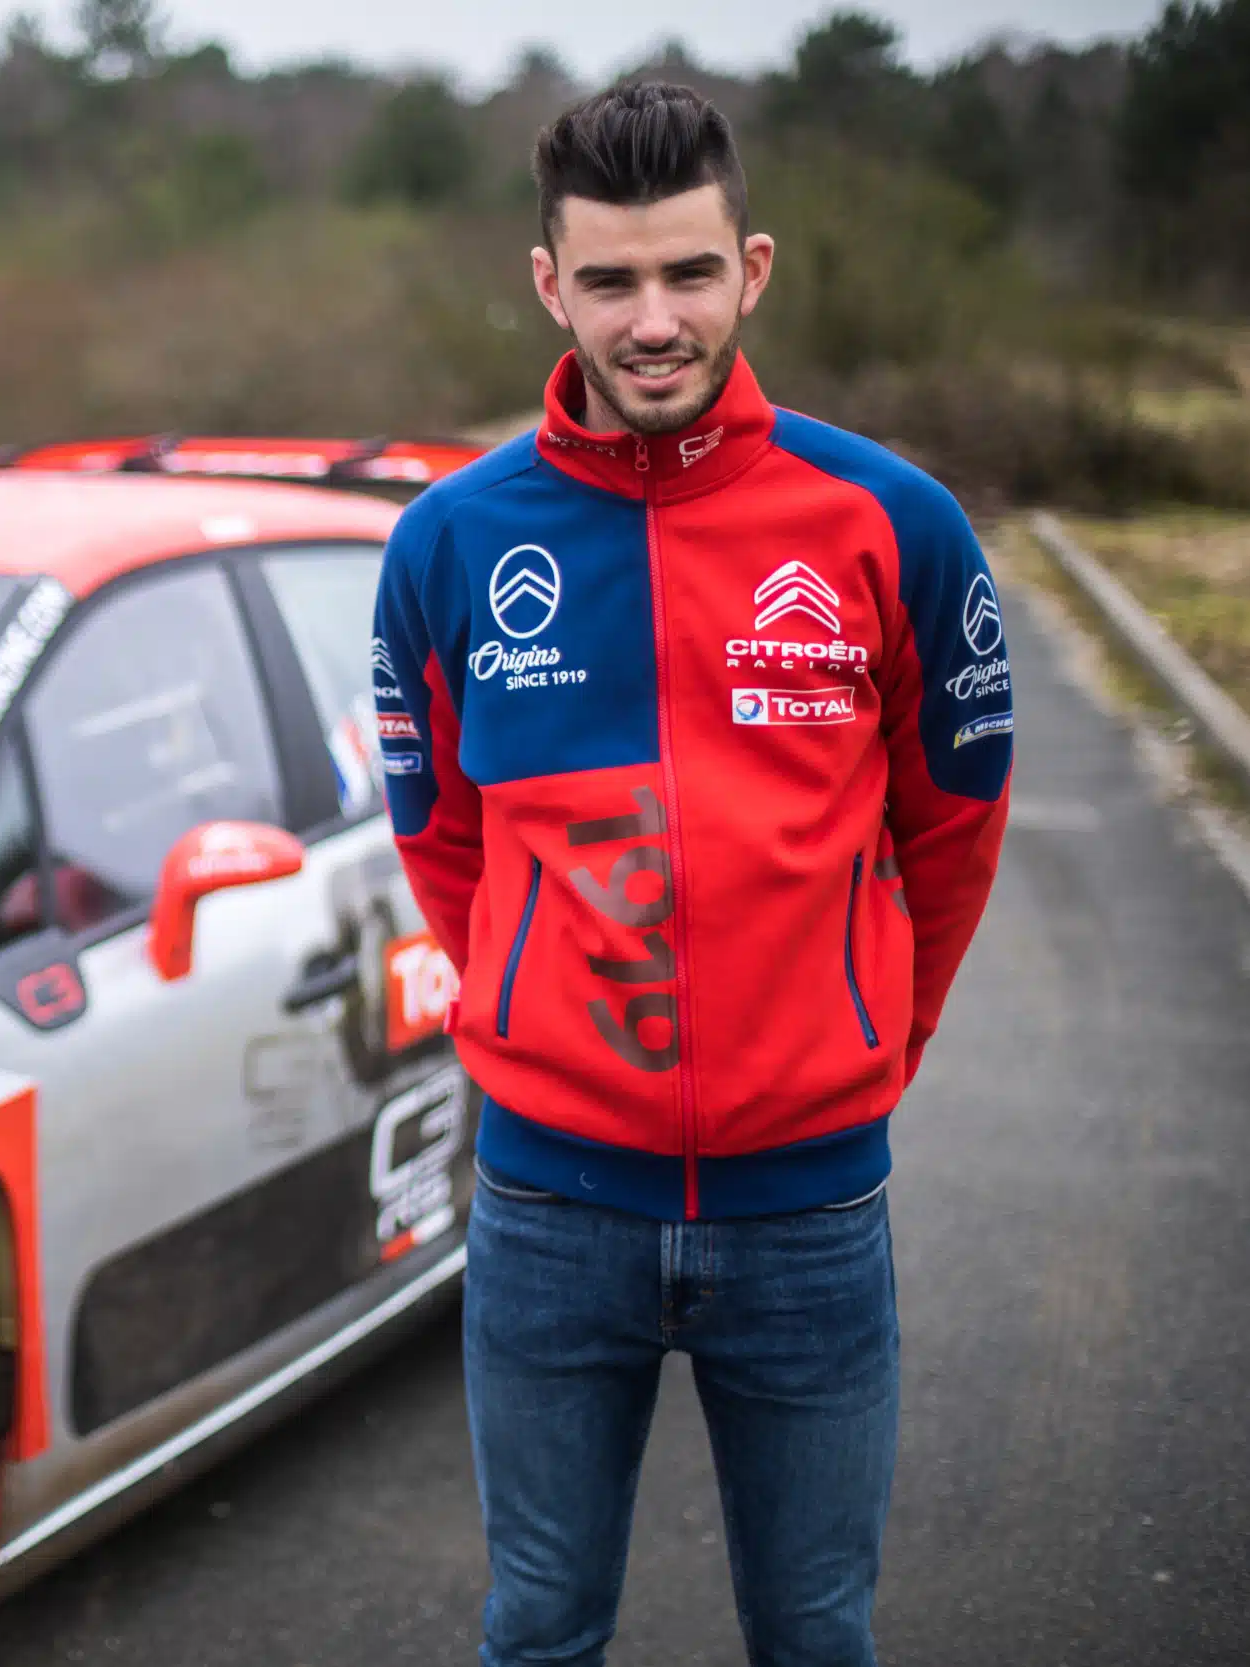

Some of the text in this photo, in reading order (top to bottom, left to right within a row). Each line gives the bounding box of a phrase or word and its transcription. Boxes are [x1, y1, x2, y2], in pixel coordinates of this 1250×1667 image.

[468, 640, 561, 681] Origins
[726, 658, 866, 674] RACING
[506, 669, 587, 691] SINCE 1919
[945, 658, 1010, 700] Origin
[975, 679, 1010, 699] SINCE
[974, 717, 1014, 734] MICHE
[566, 784, 681, 1073] 1919
